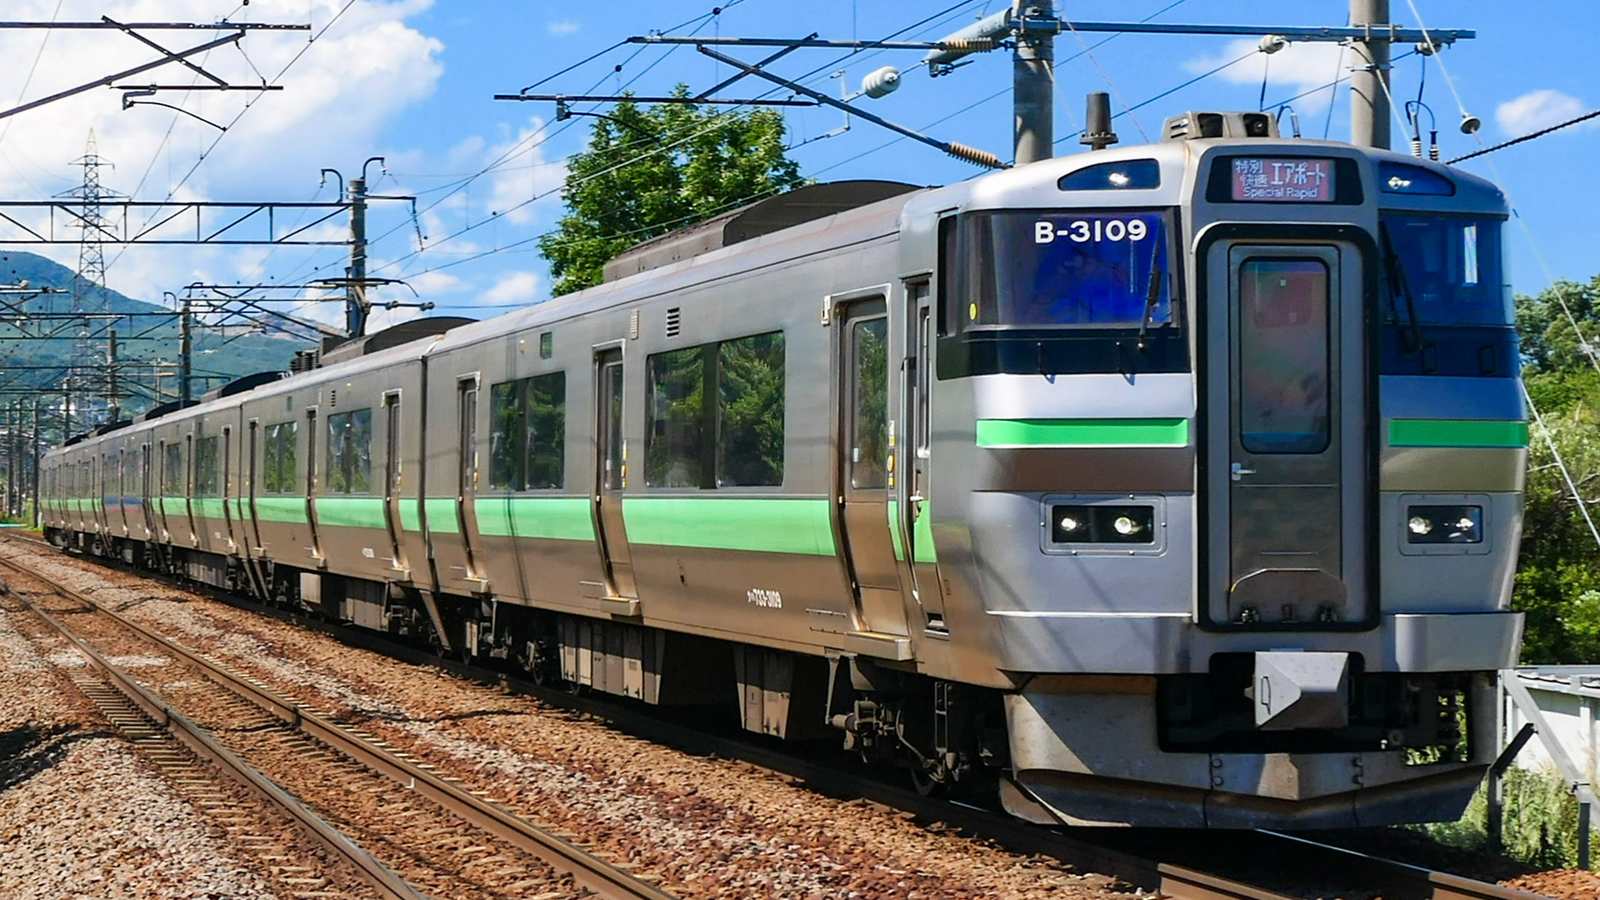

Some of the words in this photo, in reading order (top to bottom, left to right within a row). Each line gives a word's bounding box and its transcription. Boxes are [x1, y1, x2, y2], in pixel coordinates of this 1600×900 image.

[1270, 162, 1326, 186] エアポート
[1243, 187, 1284, 198] Special
[1286, 187, 1318, 199] Rapid
[1035, 219, 1147, 244] B-3109
